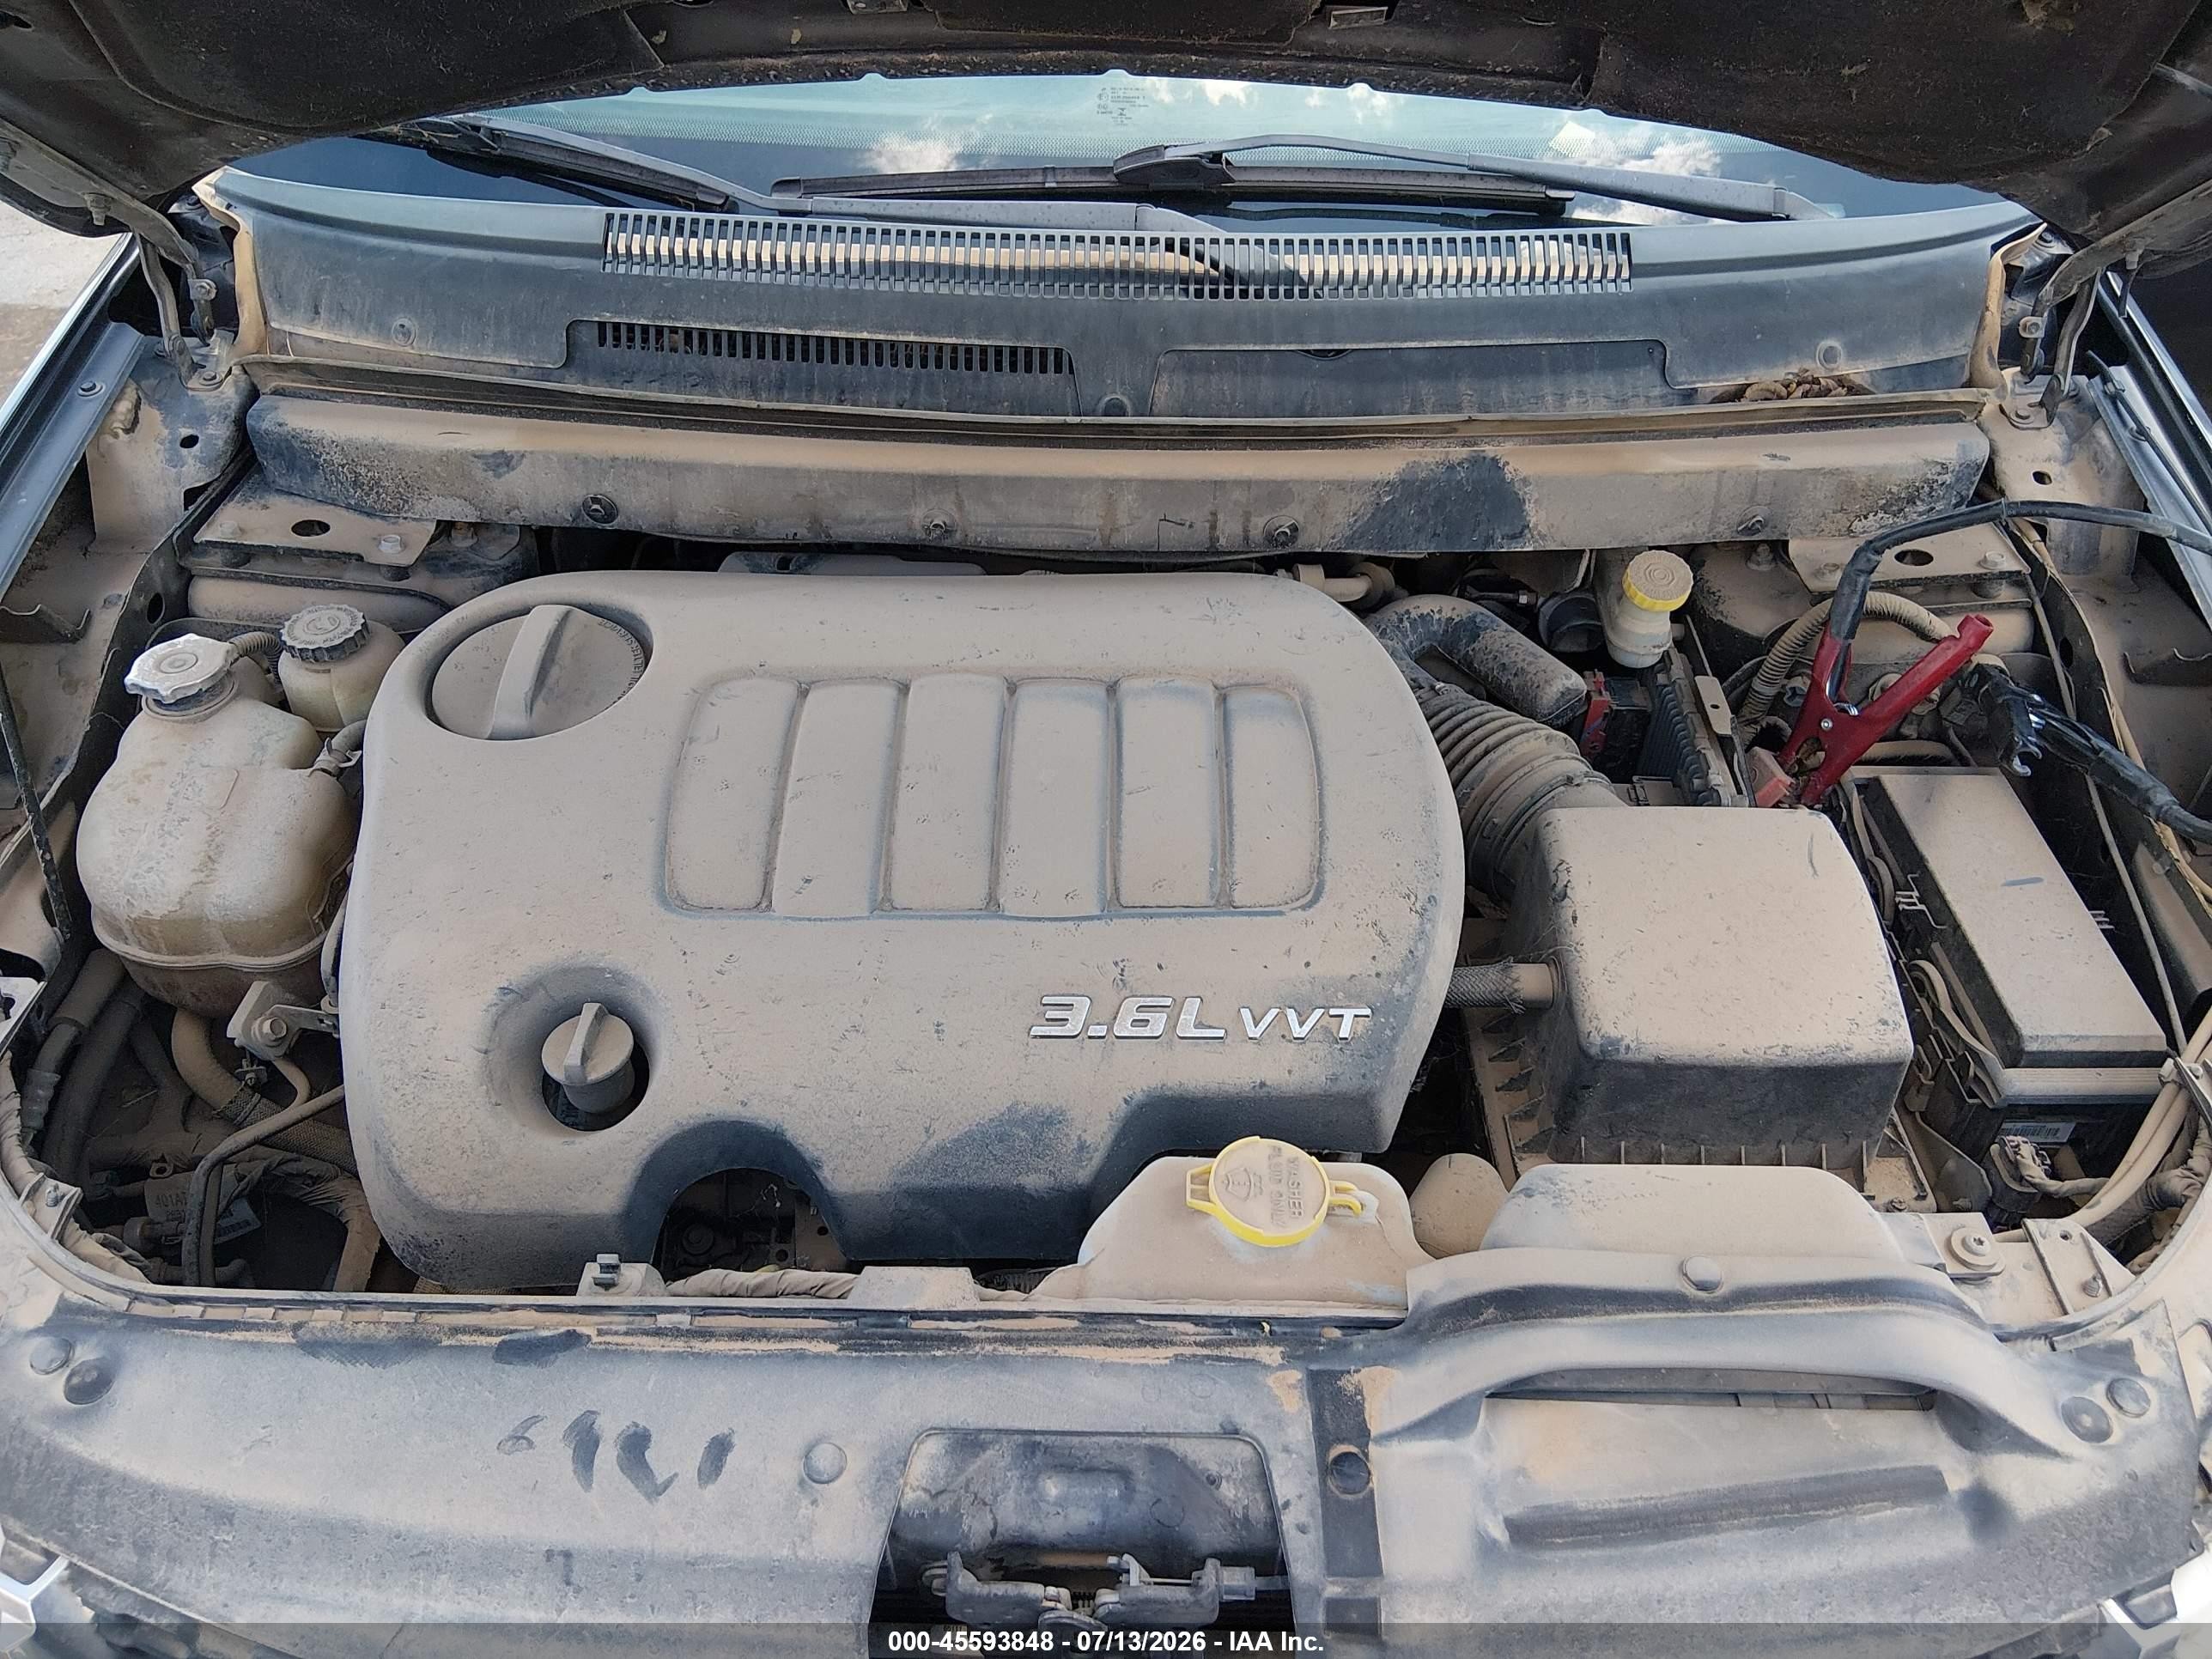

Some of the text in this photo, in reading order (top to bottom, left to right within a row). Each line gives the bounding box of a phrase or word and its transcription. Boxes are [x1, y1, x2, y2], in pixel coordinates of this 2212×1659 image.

[1030, 994, 1372, 1042] 3.6L VVT
[1288, 1156, 1304, 1219] WASHER
